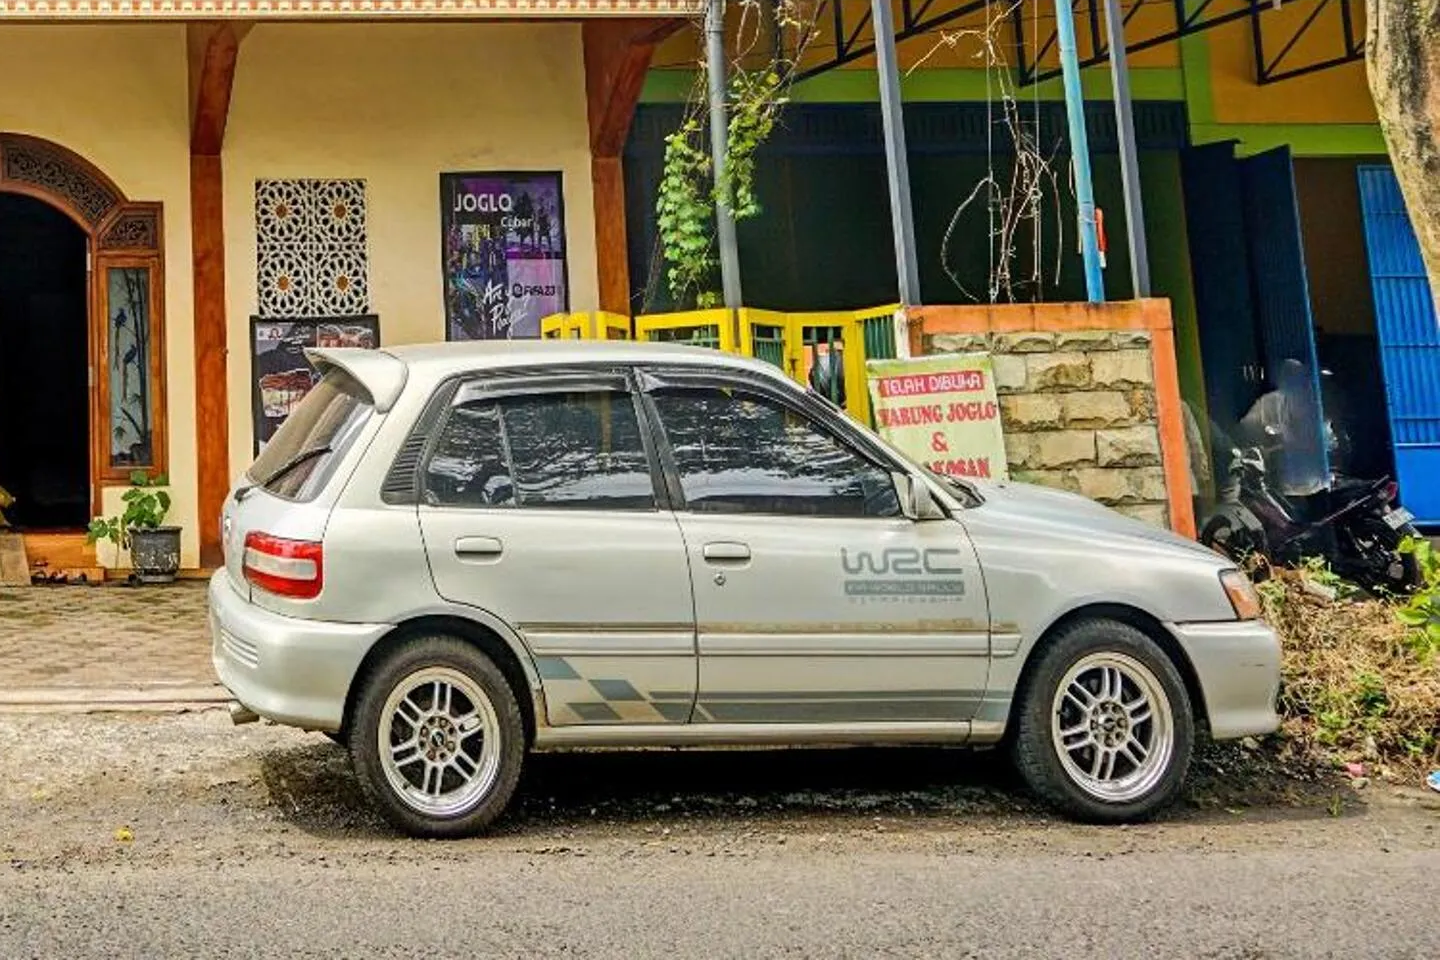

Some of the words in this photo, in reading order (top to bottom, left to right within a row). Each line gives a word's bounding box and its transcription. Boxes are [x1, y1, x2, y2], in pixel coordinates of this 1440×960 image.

[454, 193, 512, 212] JOGLO
[882, 378, 925, 397] TELAH
[929, 374, 982, 391] DIBUKA
[878, 404, 943, 427] WARUNG
[947, 401, 997, 422] JOGLO
[931, 431, 949, 452] &
[840, 547, 963, 575] WRC
